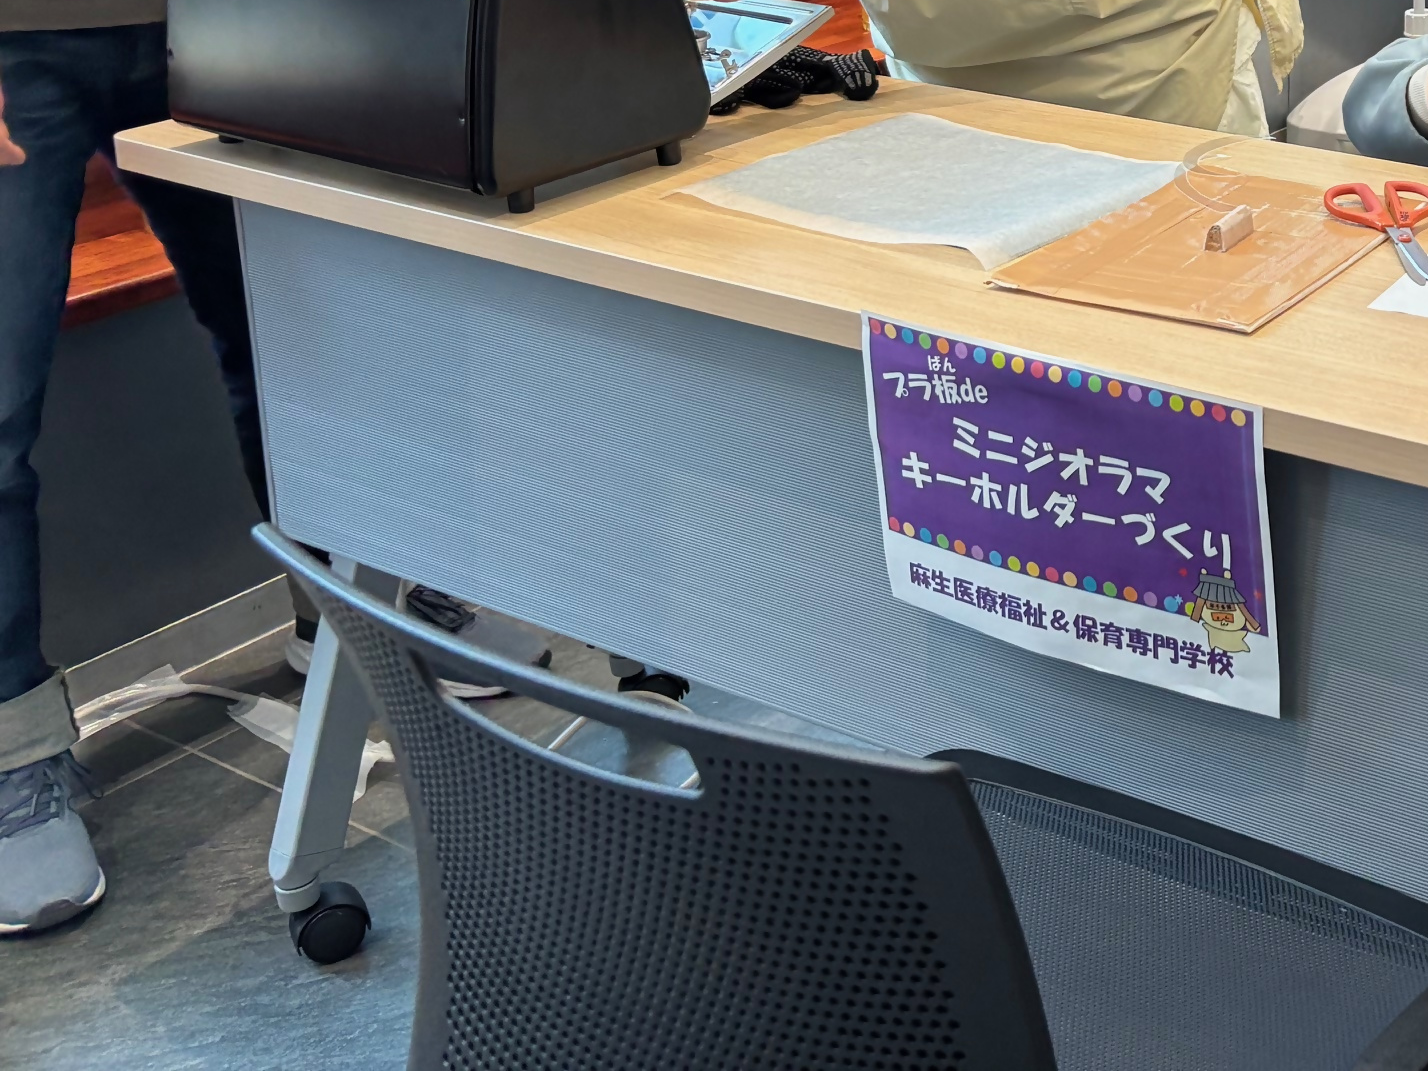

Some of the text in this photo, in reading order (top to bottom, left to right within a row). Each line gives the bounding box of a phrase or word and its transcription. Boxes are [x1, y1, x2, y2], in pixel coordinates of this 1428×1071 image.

[882, 370, 989, 406] プラ板de
[927, 354, 956, 373] ばん
[951, 415, 1172, 505] ミニジオラマ
[901, 450, 1232, 570] キーホルダーづくり
[909, 560, 1236, 680] 麻生医療福祉&保育専門学校
